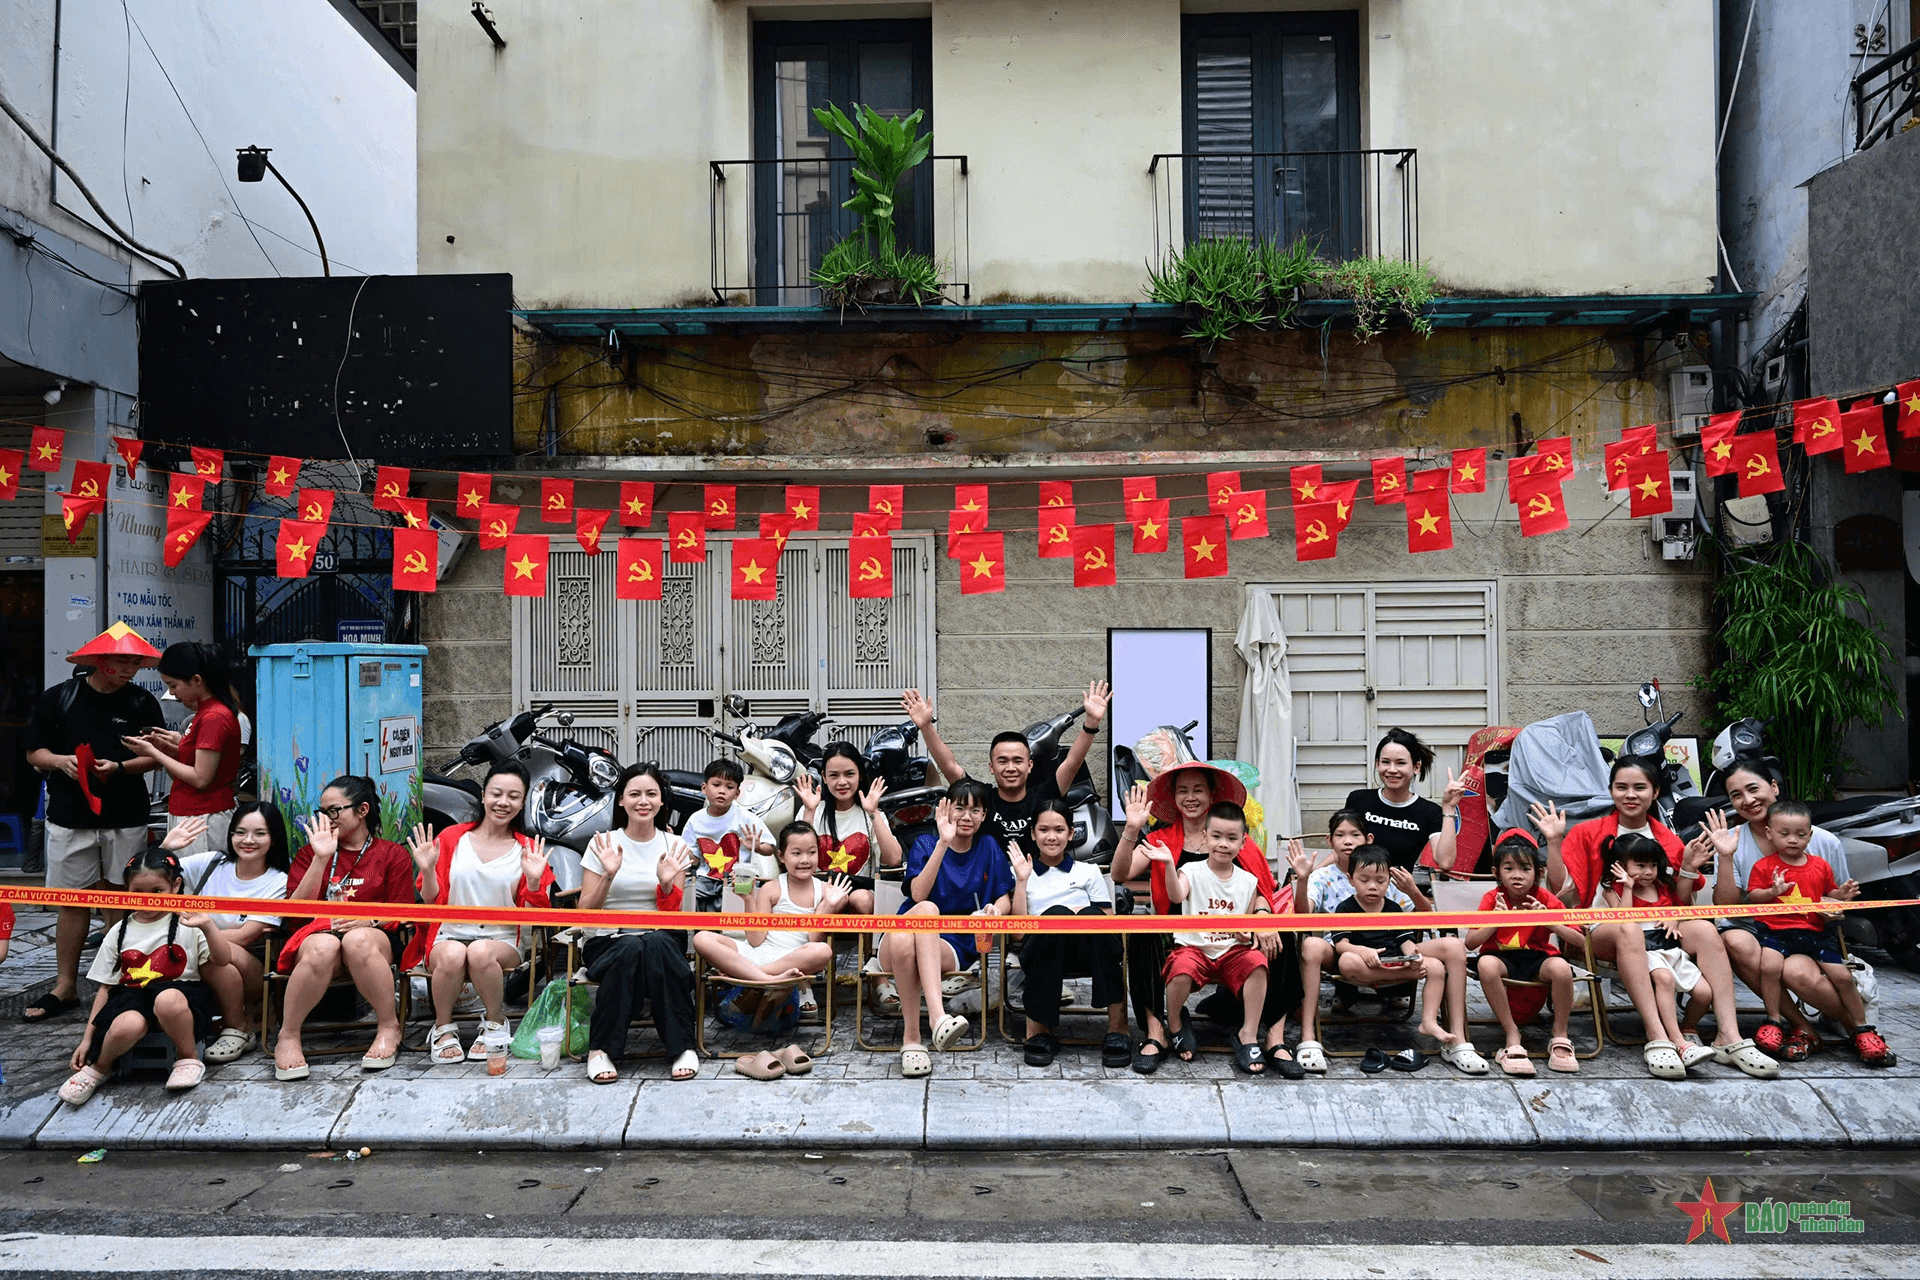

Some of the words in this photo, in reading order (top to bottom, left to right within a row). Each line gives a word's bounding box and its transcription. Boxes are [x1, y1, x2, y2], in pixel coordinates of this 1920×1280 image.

[315, 554, 334, 570] 50
[120, 560, 157, 577] HAIR
[183, 567, 211, 583] SPA
[123, 592, 138, 607] TẠO
[158, 593, 172, 607] TÓC
[360, 634, 381, 643] MINH
[1365, 811, 1420, 831] tomato.
[8, 888, 28, 899] CẤM
[30, 891, 58, 901] VƯỢT
[60, 893, 79, 902] QUA
[87, 895, 119, 904] POLICE
[122, 896, 145, 905] LINE.
[148, 898, 161, 906] DO
[163, 899, 182, 907] NOT
[184, 900, 216, 909] CROSS
[1208, 898, 1234, 911] 1994
[719, 915, 745, 925] HÀNG
[748, 915, 769, 926] RÀO
[845, 918, 874, 929] VƯỢT
[876, 919, 897, 928] QUA
[905, 920, 939, 929] POLICE
[968, 920, 982, 928] DO
[985, 920, 1004, 929] NOT
[1007, 920, 1039, 930] CROSS
[1562, 911, 1592, 921] HÀNG
